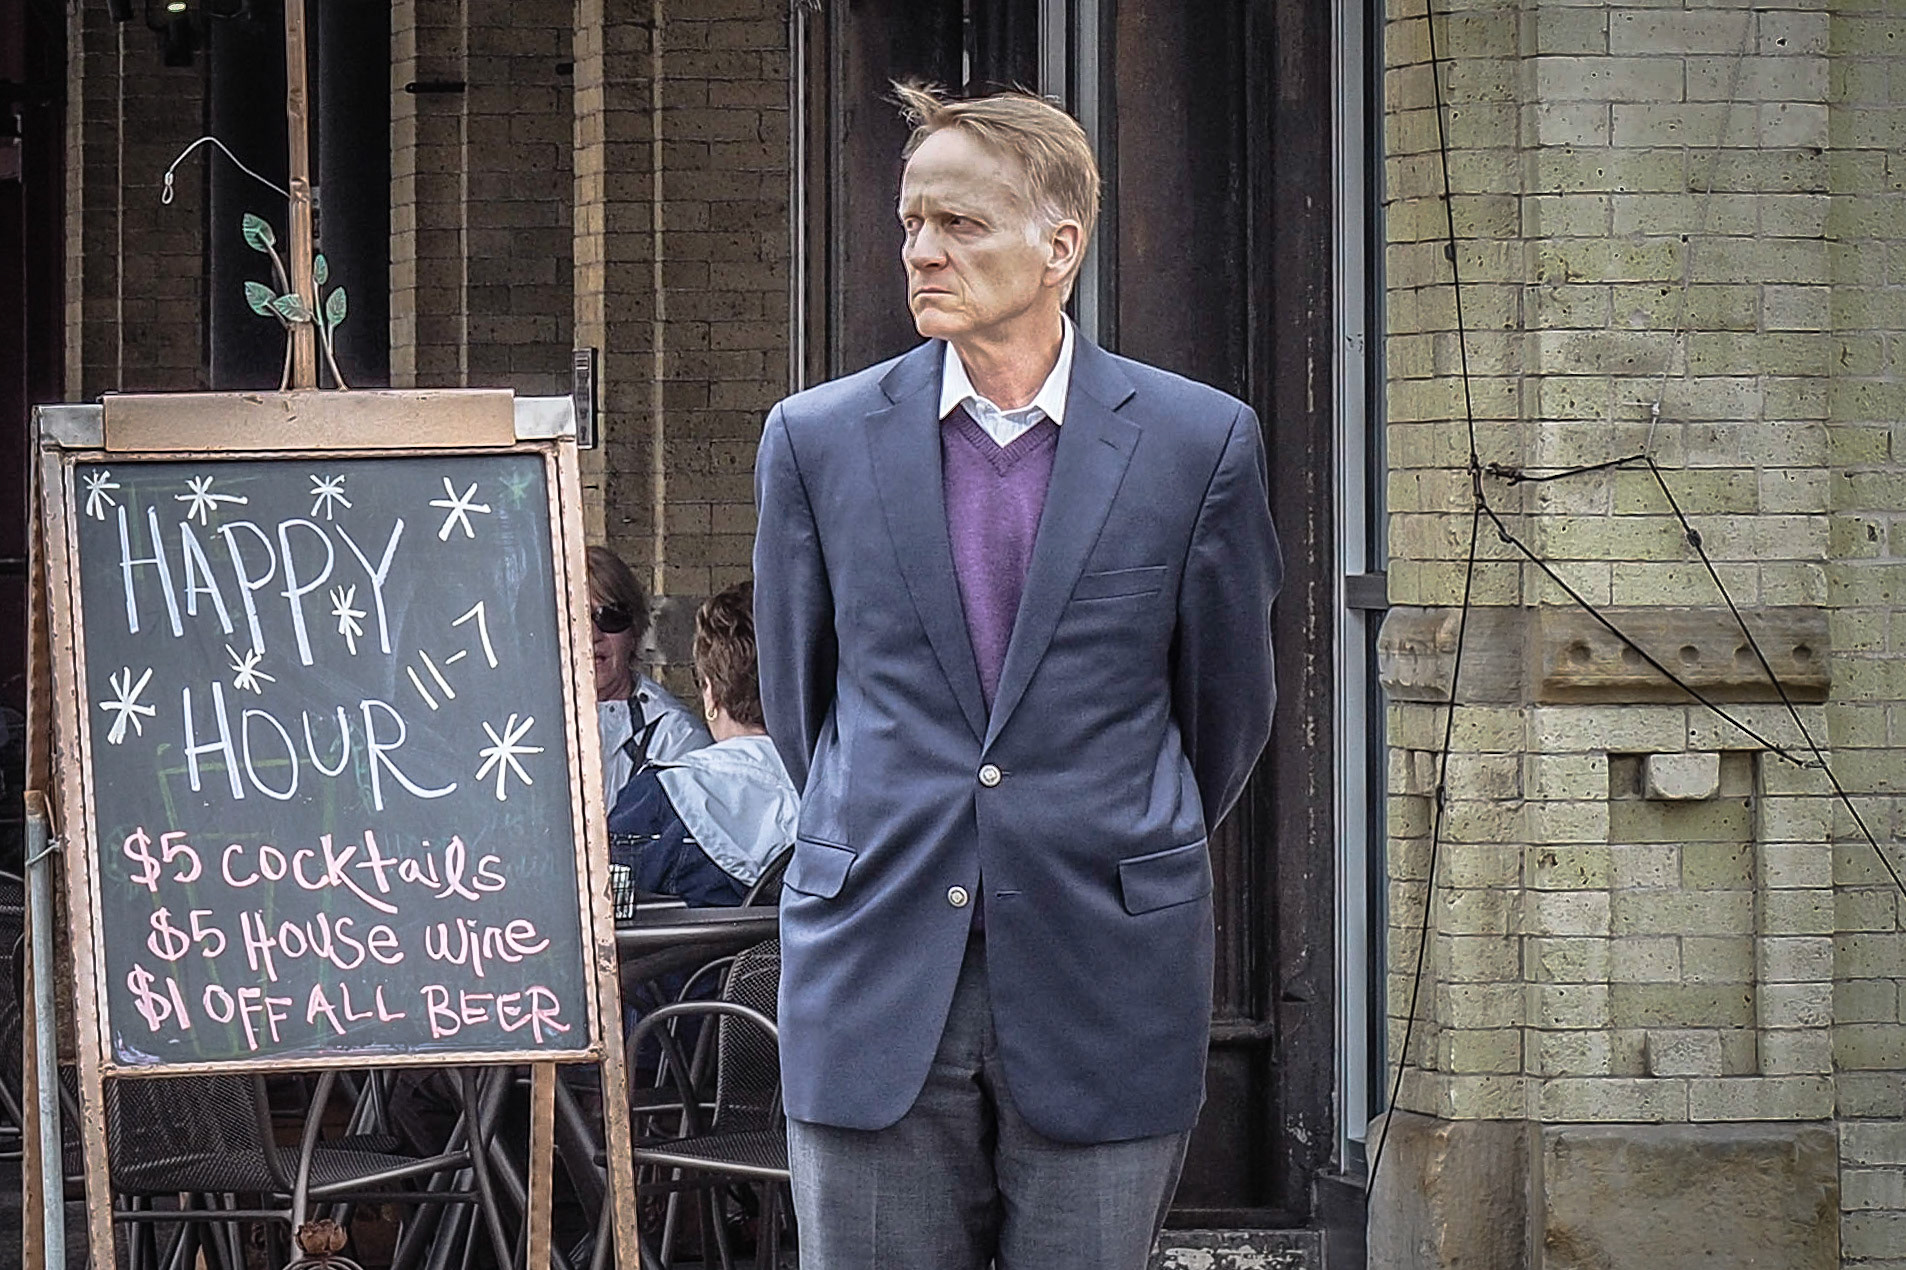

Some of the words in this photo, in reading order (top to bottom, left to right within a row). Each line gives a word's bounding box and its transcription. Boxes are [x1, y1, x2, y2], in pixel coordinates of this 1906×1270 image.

[118, 505, 405, 666] HAPPY
[183, 681, 457, 812] HOUR
[123, 827, 202, 893] $5
[147, 907, 226, 961] $5
[127, 963, 190, 1032] $1
[203, 984, 293, 1050] OFF
[306, 983, 406, 1035] ALL
[420, 984, 571, 1044] BEER
